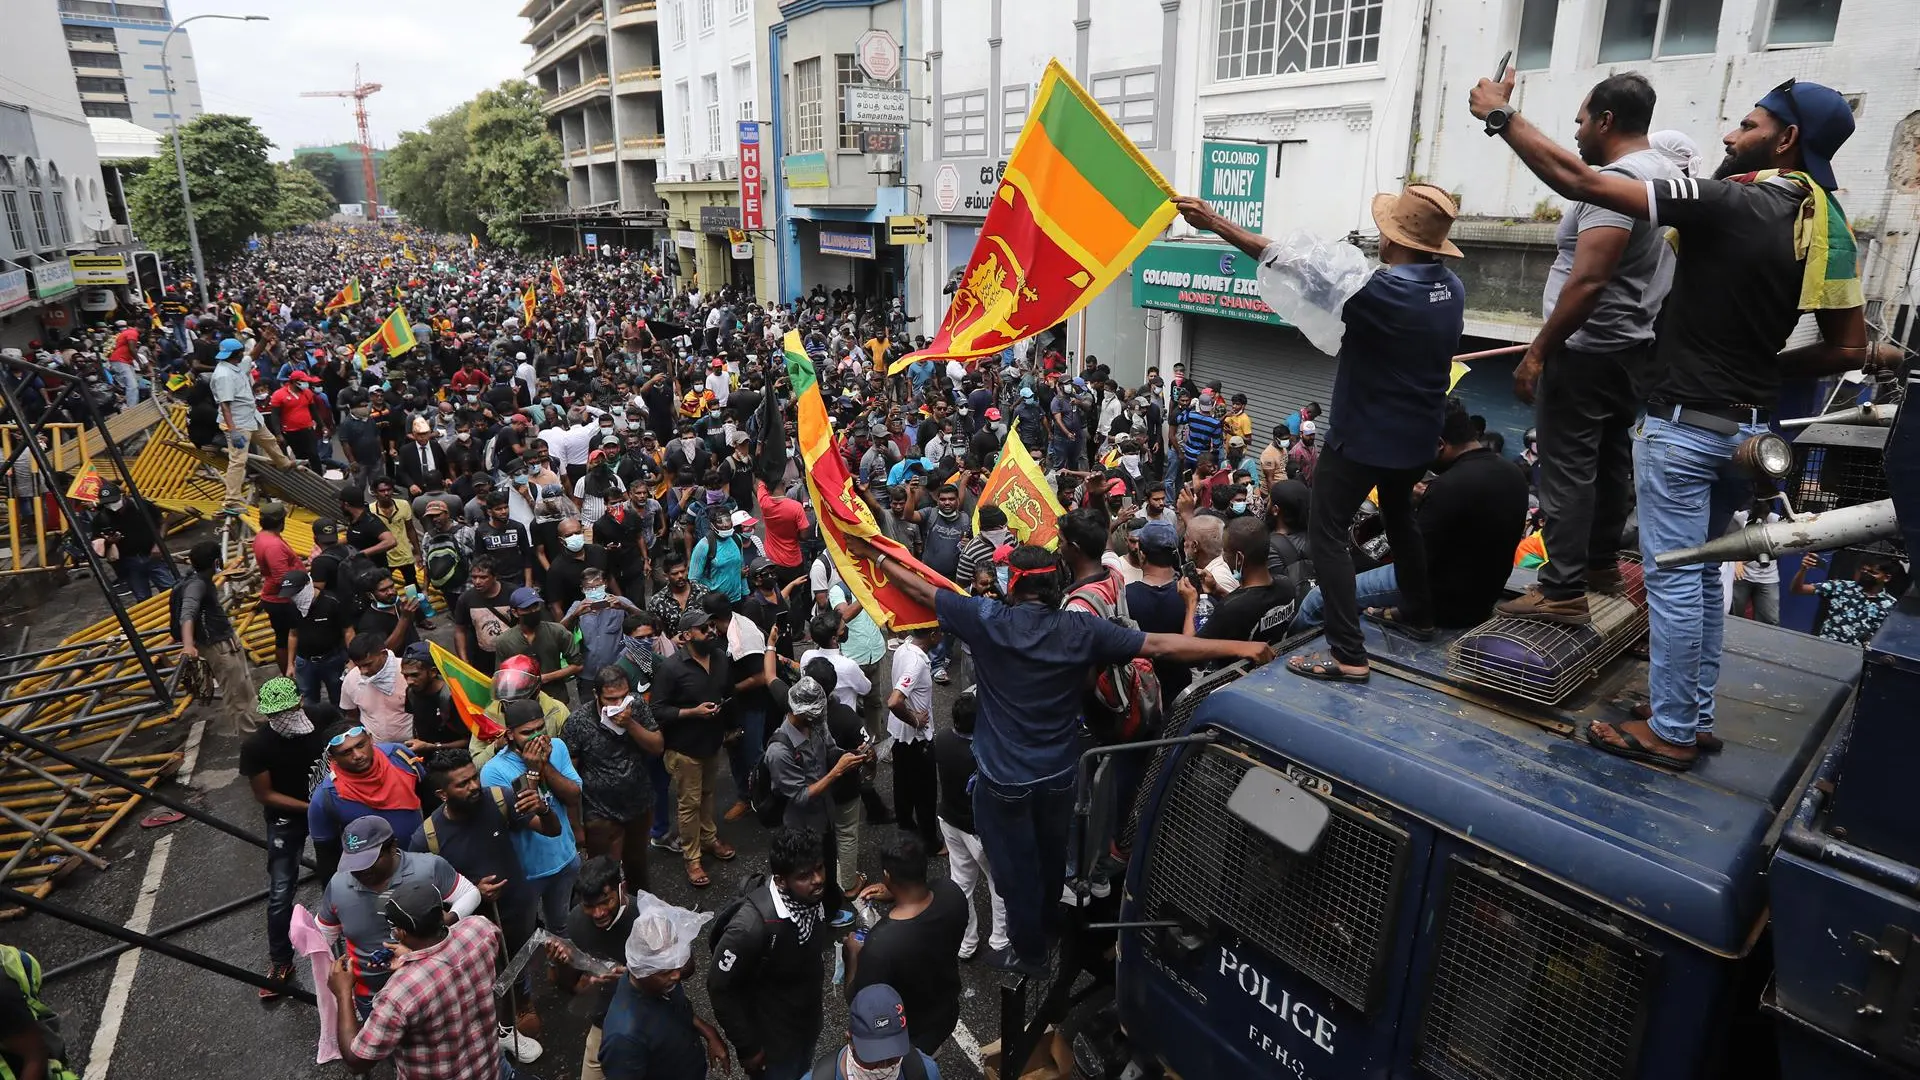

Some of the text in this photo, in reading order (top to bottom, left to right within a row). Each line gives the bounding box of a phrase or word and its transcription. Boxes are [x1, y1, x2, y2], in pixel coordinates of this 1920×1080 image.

[1211, 150, 1260, 165] COLOMBO
[743, 148, 759, 229] HOTEL
[1212, 168, 1255, 197] MONEY
[1206, 200, 1262, 228] CHANGE
[1143, 269, 1191, 288] COLOMBO
[1192, 274, 1233, 292] MONEY
[1178, 290, 1276, 313] MONEY CHANGE
[1196, 306, 1219, 314] COLOMBO
[718, 949, 737, 972] 3
[1219, 946, 1337, 1055] POLICE
